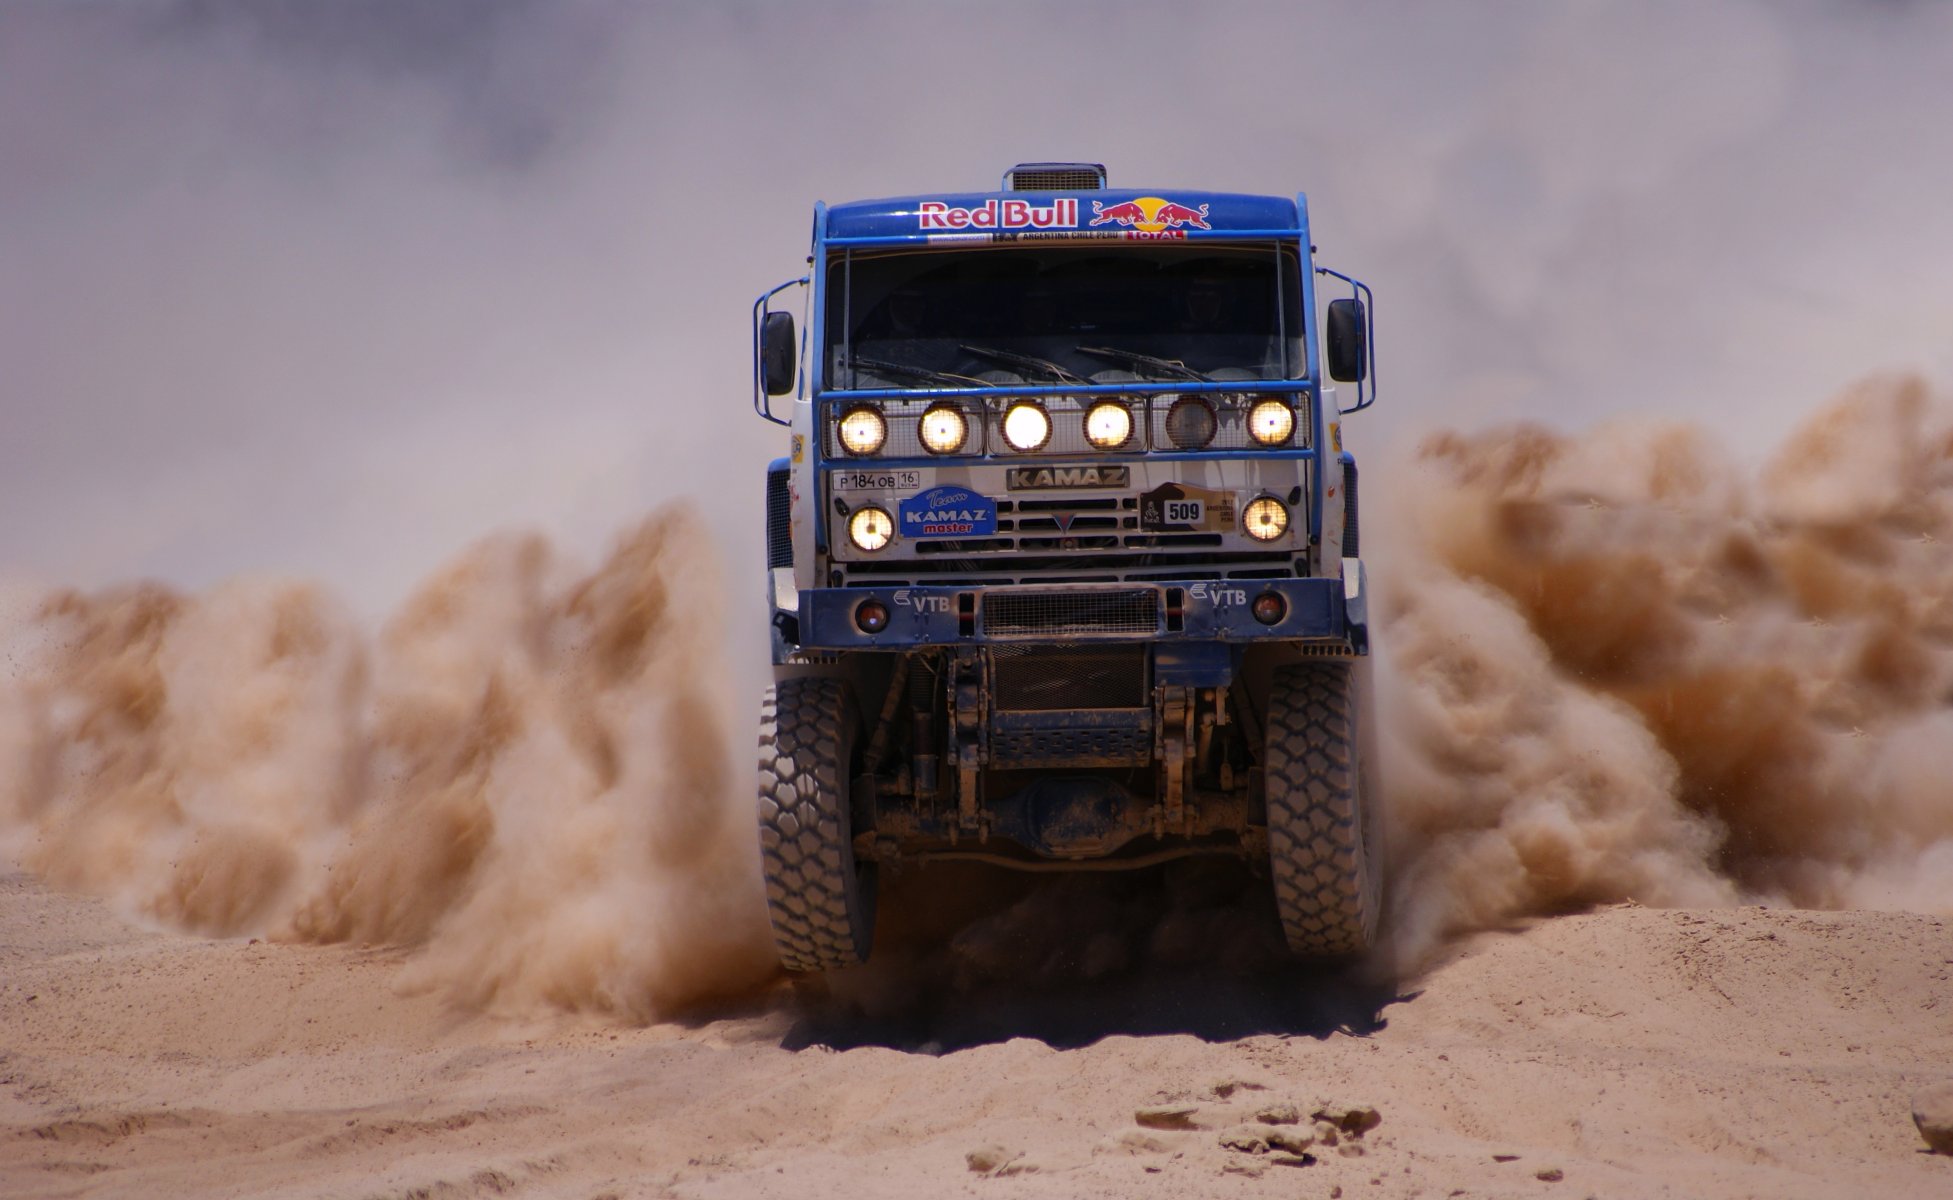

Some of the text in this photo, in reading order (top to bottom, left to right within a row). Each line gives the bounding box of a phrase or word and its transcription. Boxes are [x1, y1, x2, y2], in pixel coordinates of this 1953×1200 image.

[919, 198, 1078, 229] Red Bull
[1022, 232, 1070, 240] ARGENTINA
[1132, 231, 1180, 240] TOTAL
[851, 474, 875, 488] 184
[901, 473, 914, 483] 16
[1011, 468, 1125, 487] KAMAZ
[926, 489, 968, 509] Team
[906, 509, 987, 523] KAMAZ
[1169, 502, 1200, 520] 509
[923, 522, 974, 535] master
[913, 596, 950, 613] VTB
[1210, 589, 1247, 606] VTB
